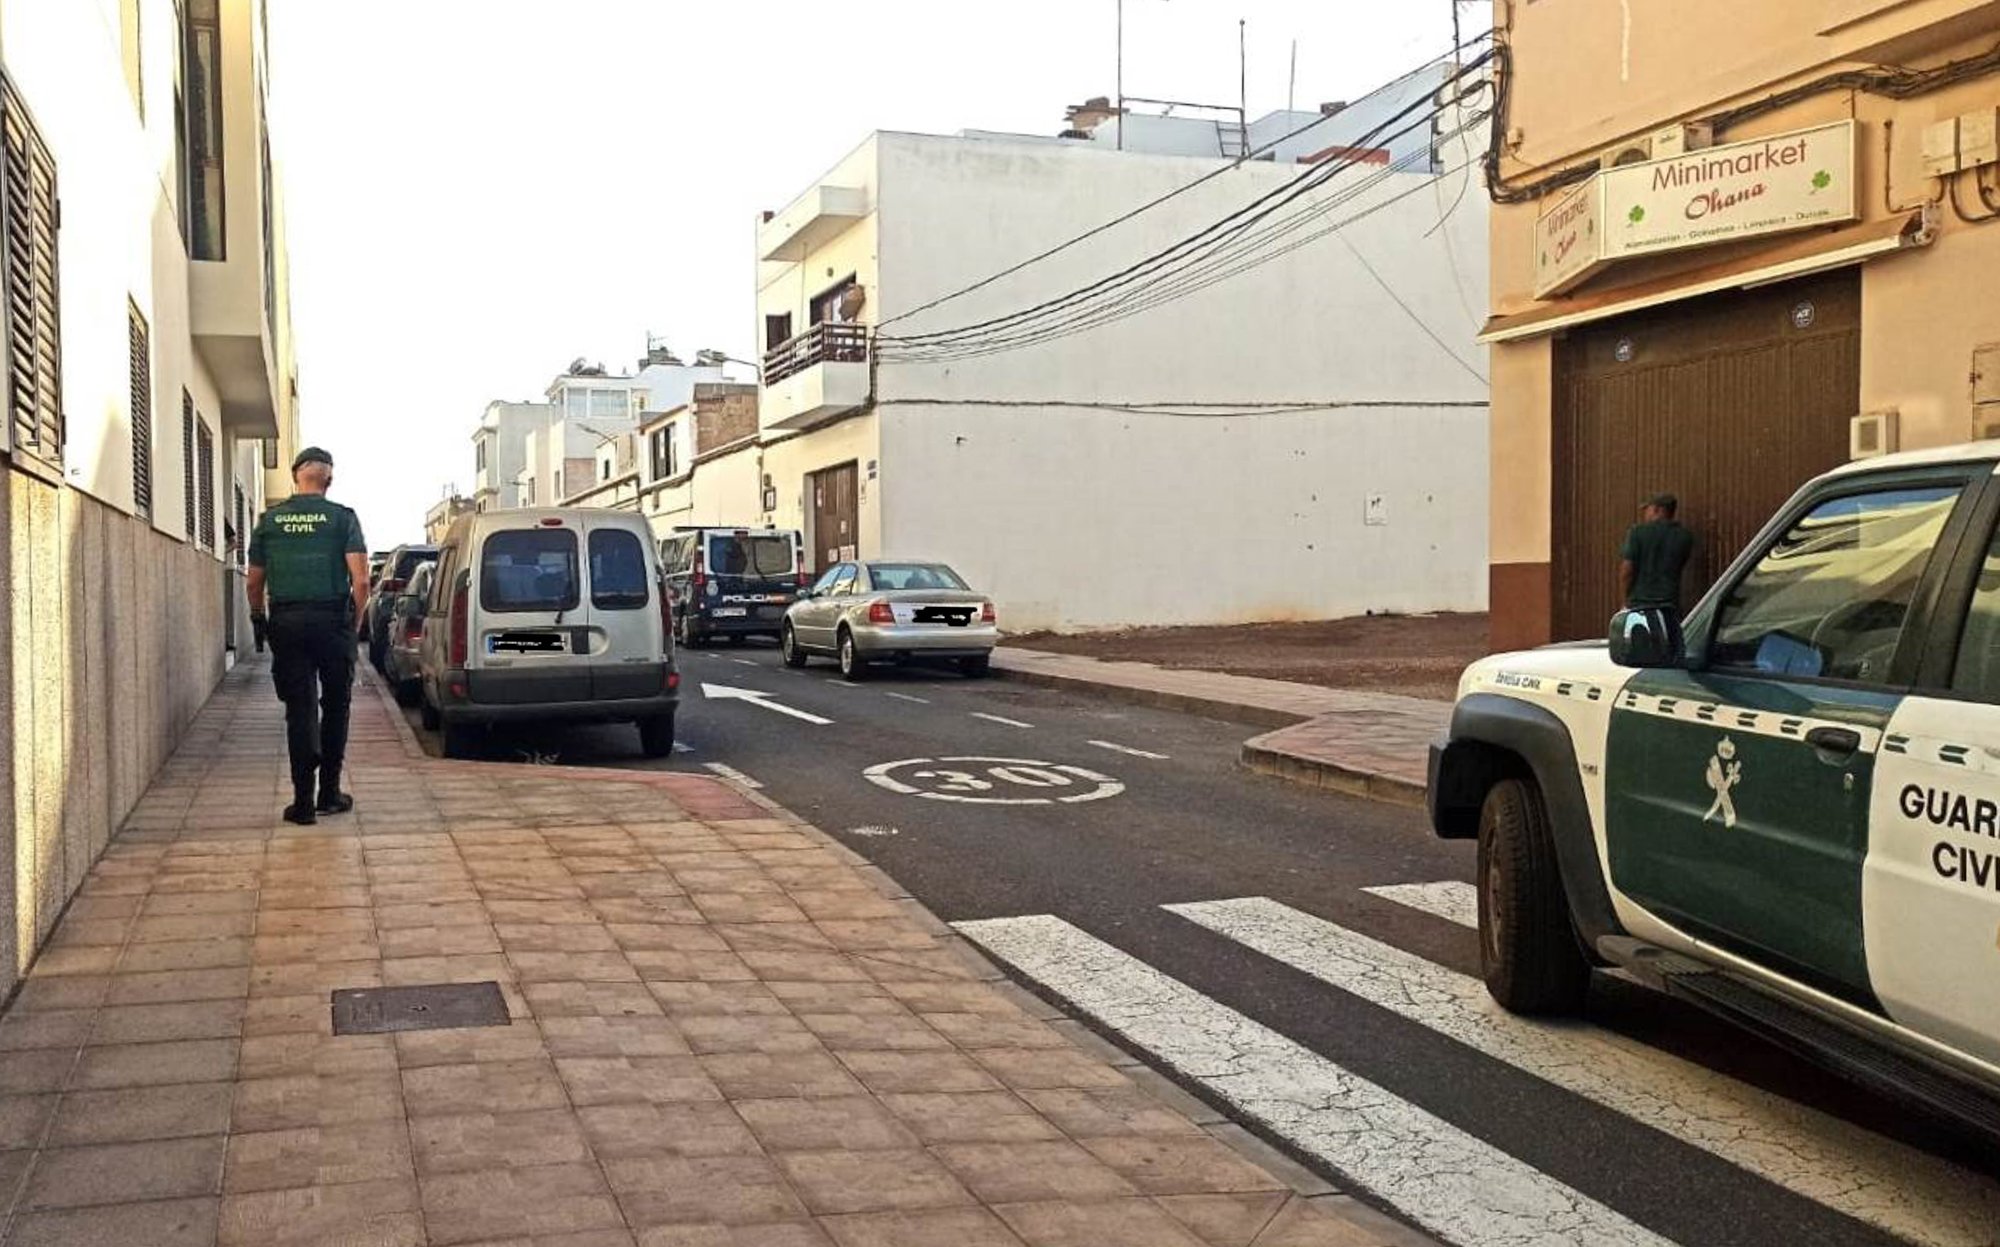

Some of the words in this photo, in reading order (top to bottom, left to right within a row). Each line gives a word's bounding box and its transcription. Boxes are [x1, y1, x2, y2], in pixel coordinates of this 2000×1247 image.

[1652, 138, 1807, 192] Minimarket
[1684, 182, 1768, 220] Ohana
[275, 513, 327, 523] GUARDIA
[283, 524, 316, 532] CIVIL
[913, 766, 1073, 791] 30
[1899, 783, 2000, 839] GUAR
